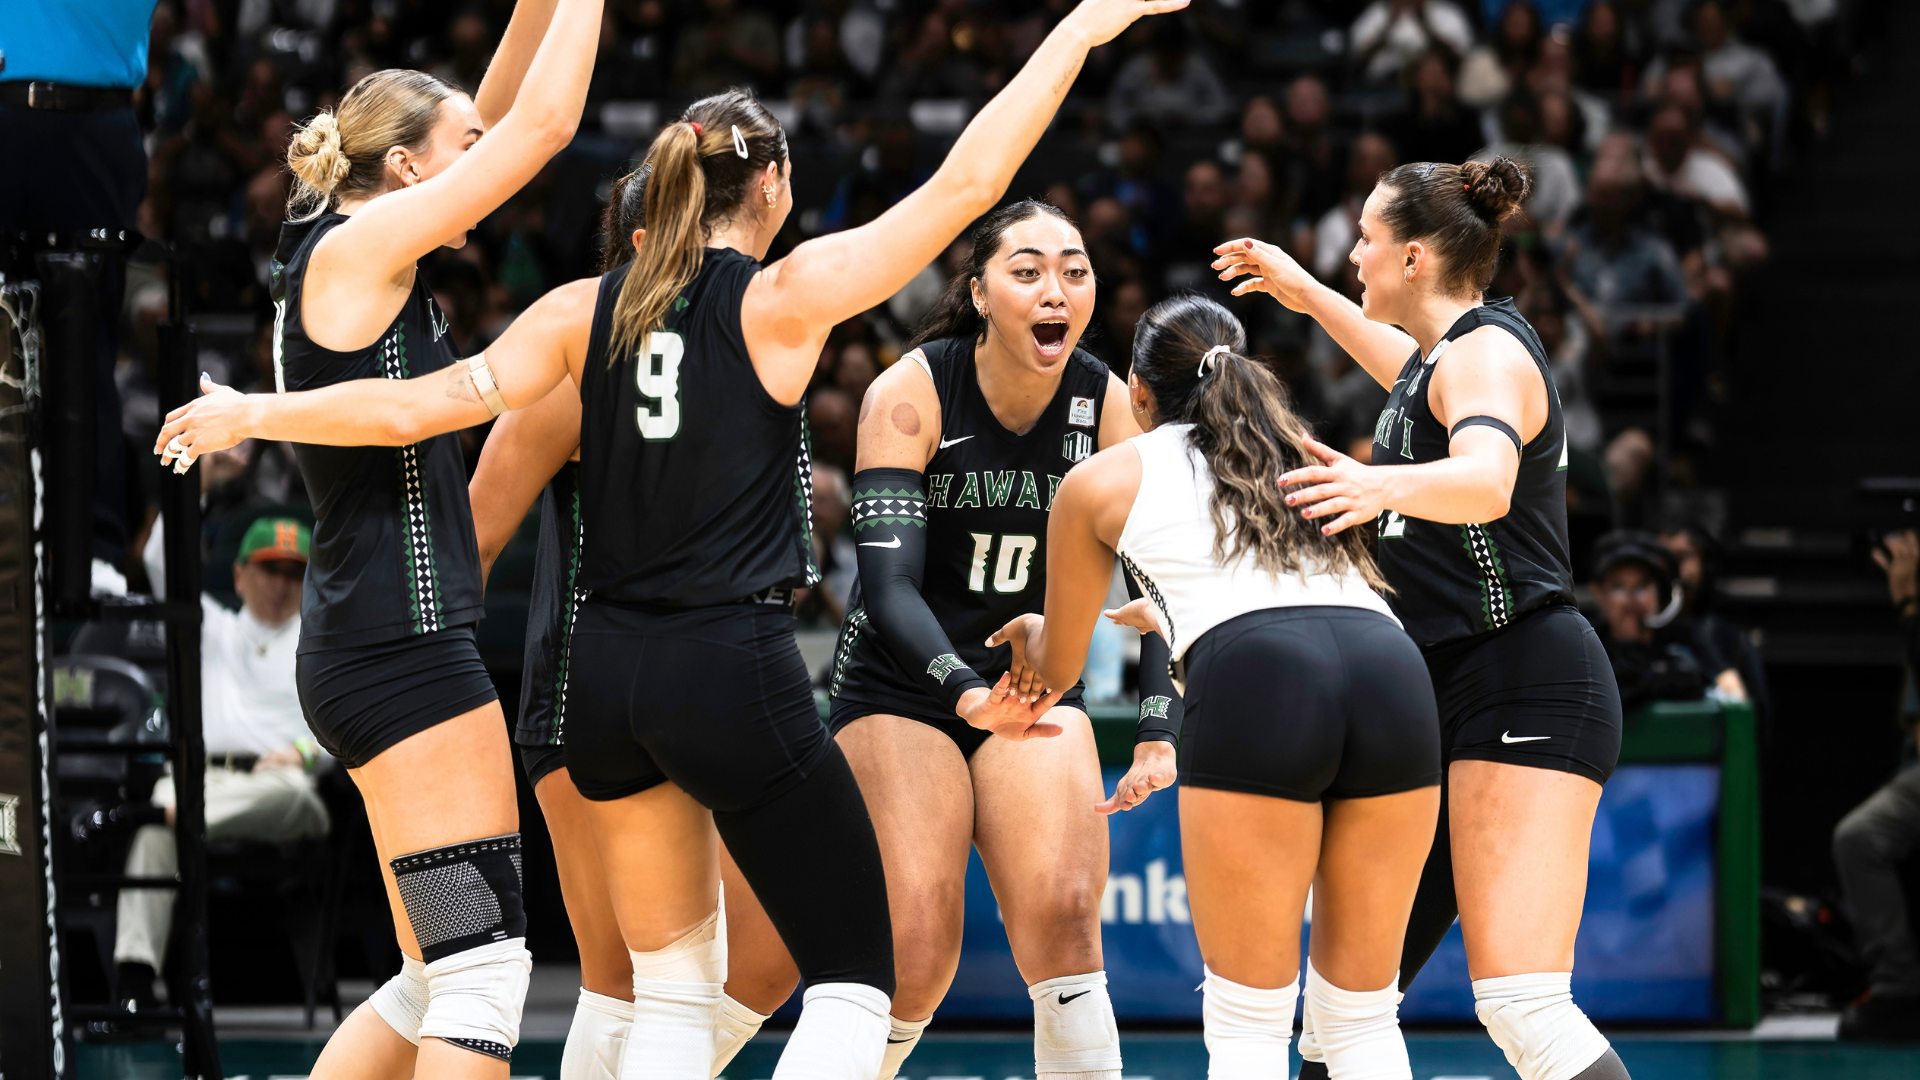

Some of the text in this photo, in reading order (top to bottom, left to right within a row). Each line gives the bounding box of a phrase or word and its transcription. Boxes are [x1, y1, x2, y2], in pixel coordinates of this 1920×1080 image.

[635, 328, 686, 443] 9
[967, 530, 1039, 595] 10
[1100, 858, 1193, 924] nk
